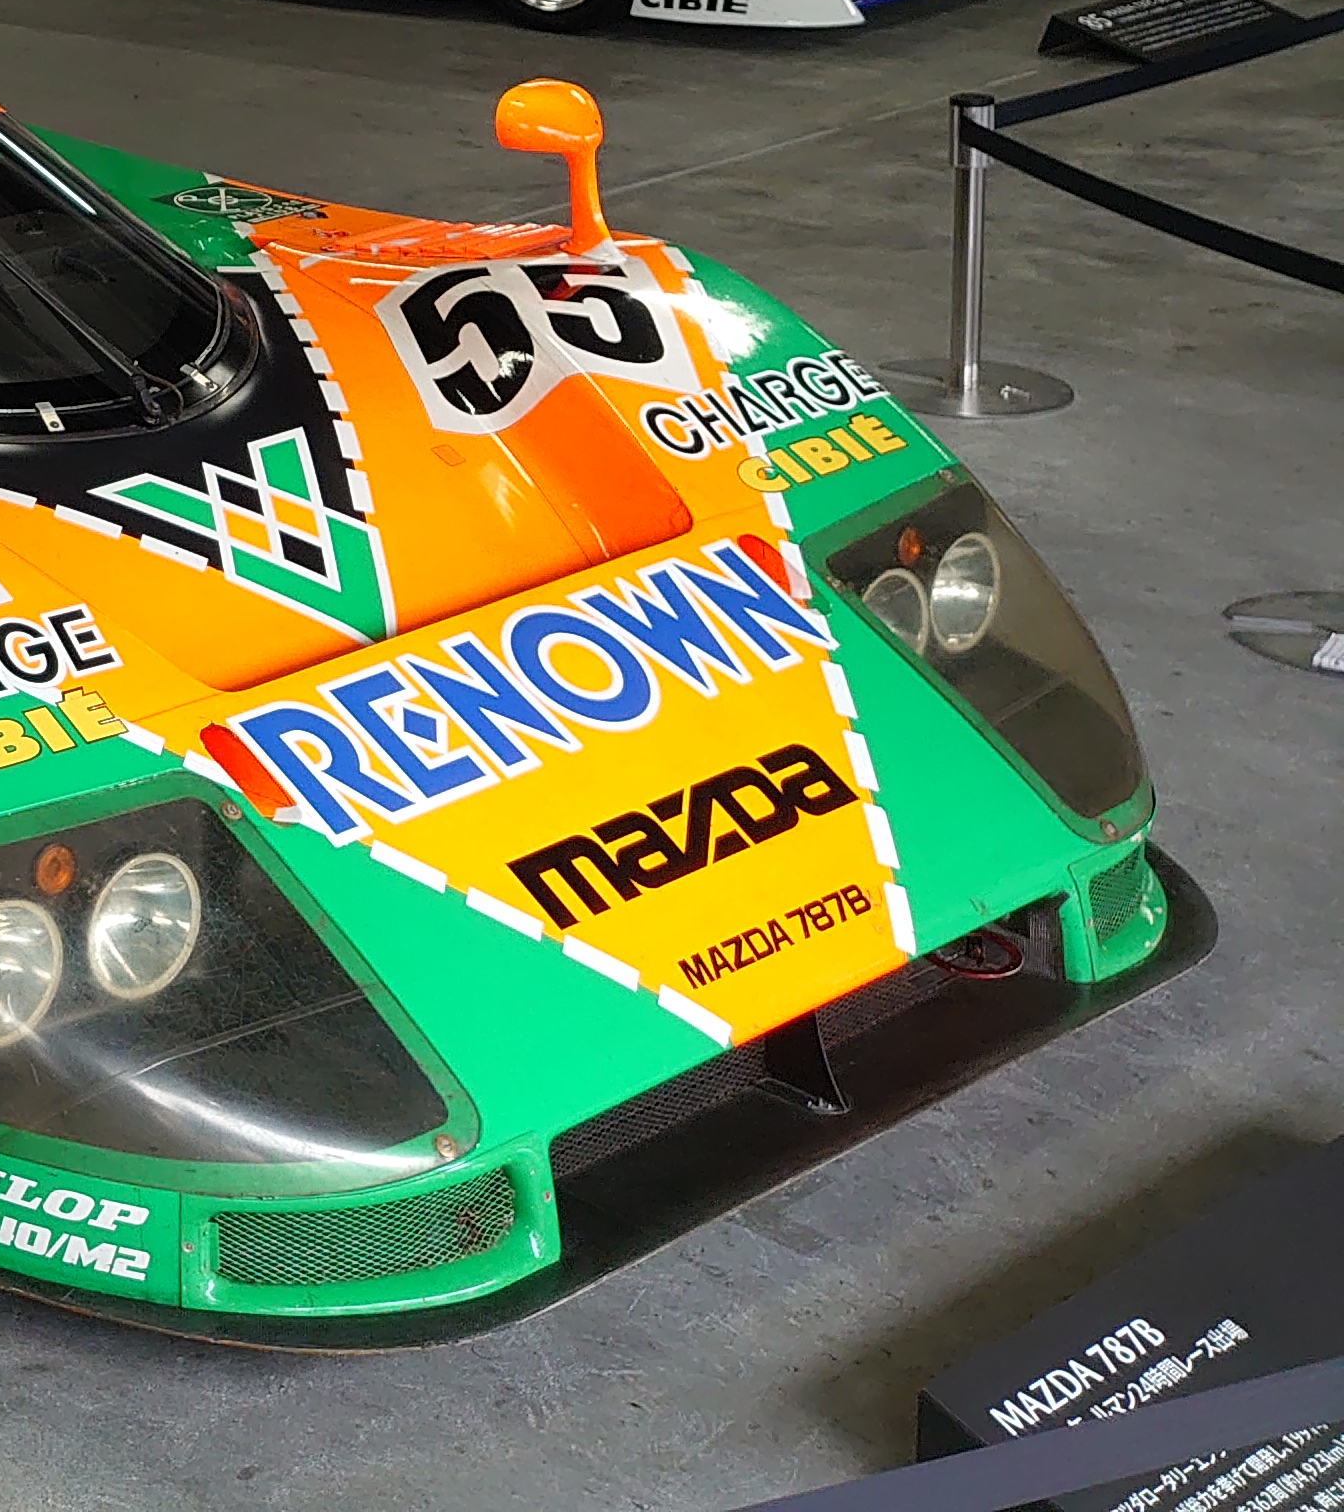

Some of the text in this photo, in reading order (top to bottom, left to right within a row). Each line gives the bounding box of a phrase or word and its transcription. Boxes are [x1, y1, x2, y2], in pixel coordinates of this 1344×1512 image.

[1077, 11, 1113, 31] 85
[398, 264, 666, 415] 55
[641, 351, 885, 461] CHARGE
[736, 413, 908, 493] CIBIÉ
[226, 539, 839, 847] RENOWN
[506, 743, 860, 930] mazda
[678, 882, 873, 990] MAZDA 787B
[989, 1317, 1166, 1437] MAZDA 787B
